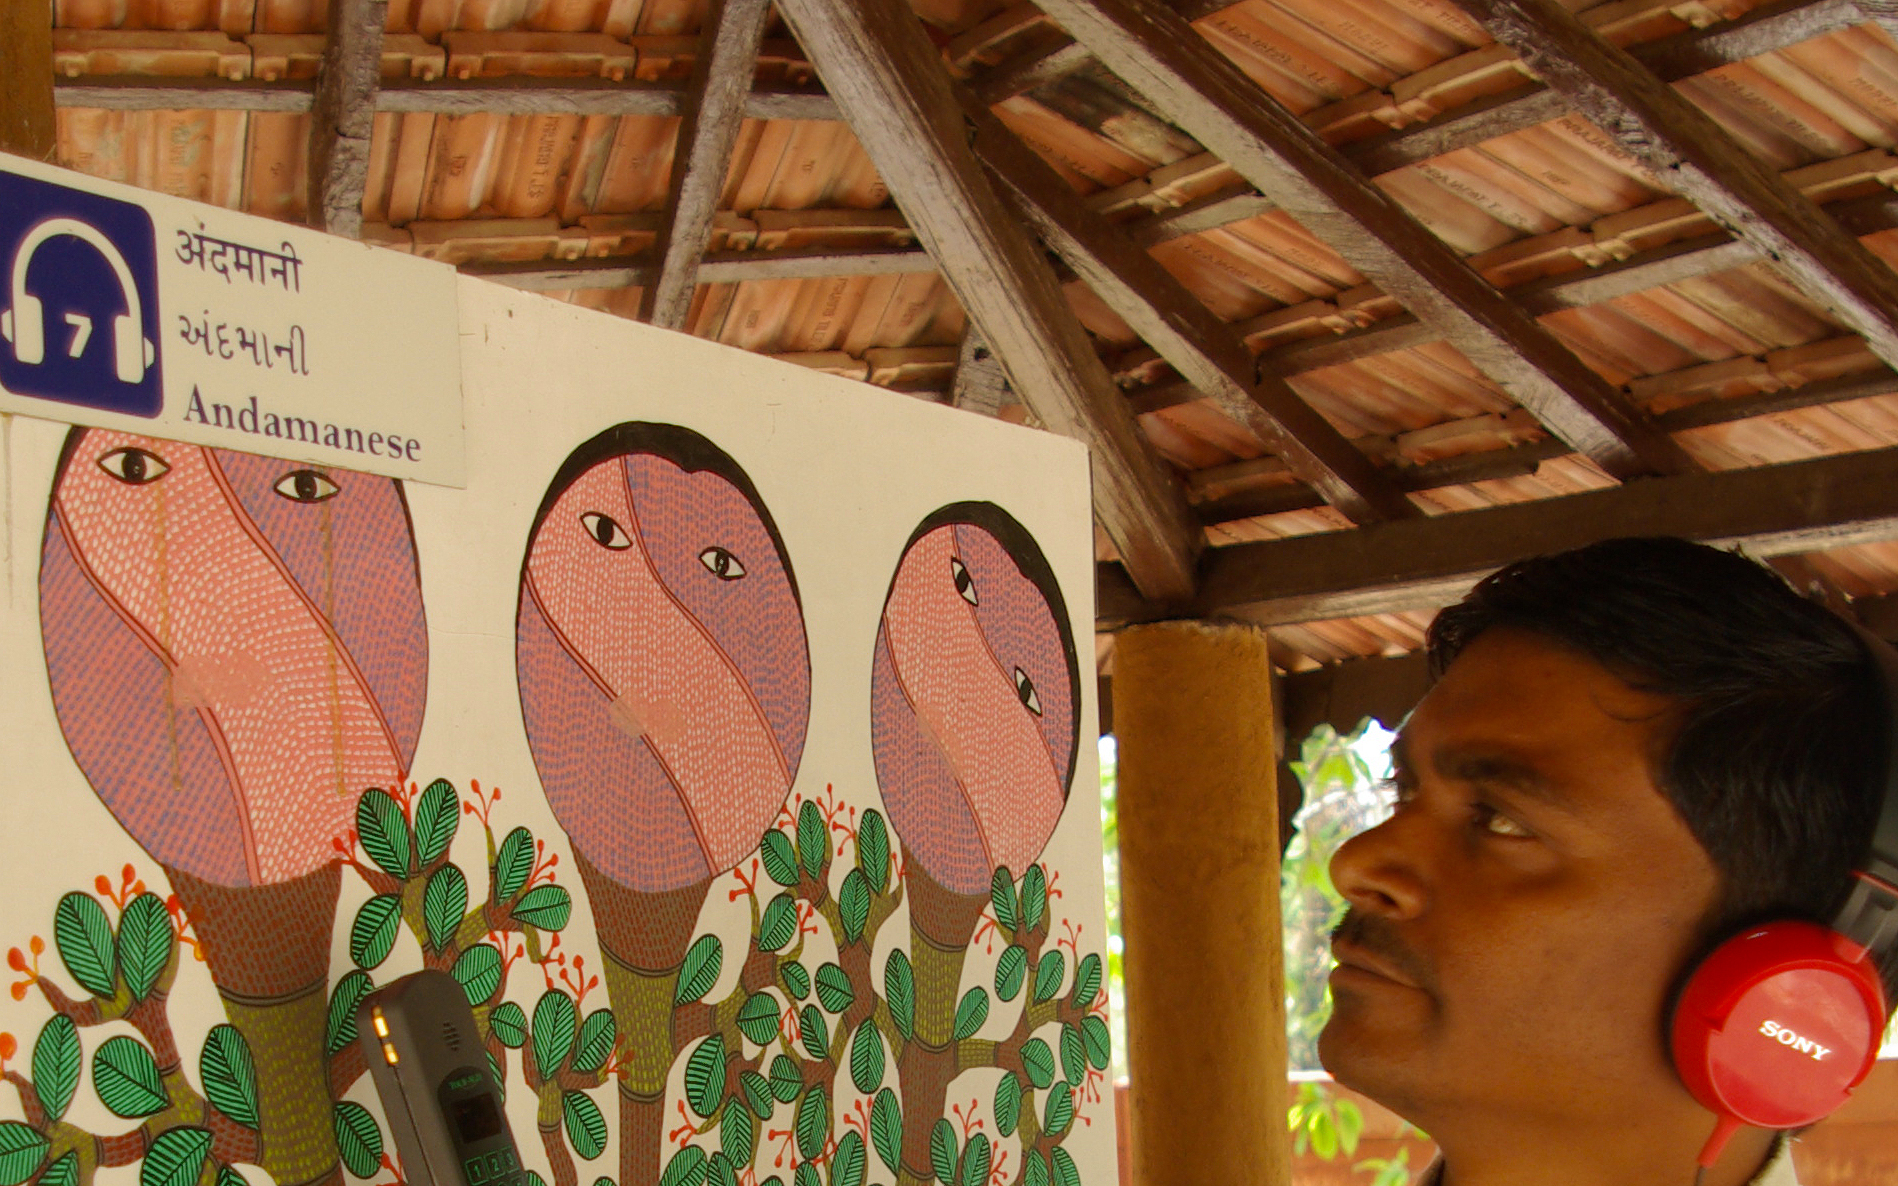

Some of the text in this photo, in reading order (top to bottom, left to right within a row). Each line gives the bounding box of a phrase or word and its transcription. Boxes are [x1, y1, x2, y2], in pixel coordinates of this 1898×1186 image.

[175, 222, 303, 294] अंदमानी
[64, 312, 93, 358] 7
[178, 309, 309, 376] અંદમાની
[183, 383, 422, 462] Andamanese
[1758, 1020, 1831, 1061] SONY
[491, 1157, 500, 1172] 2
